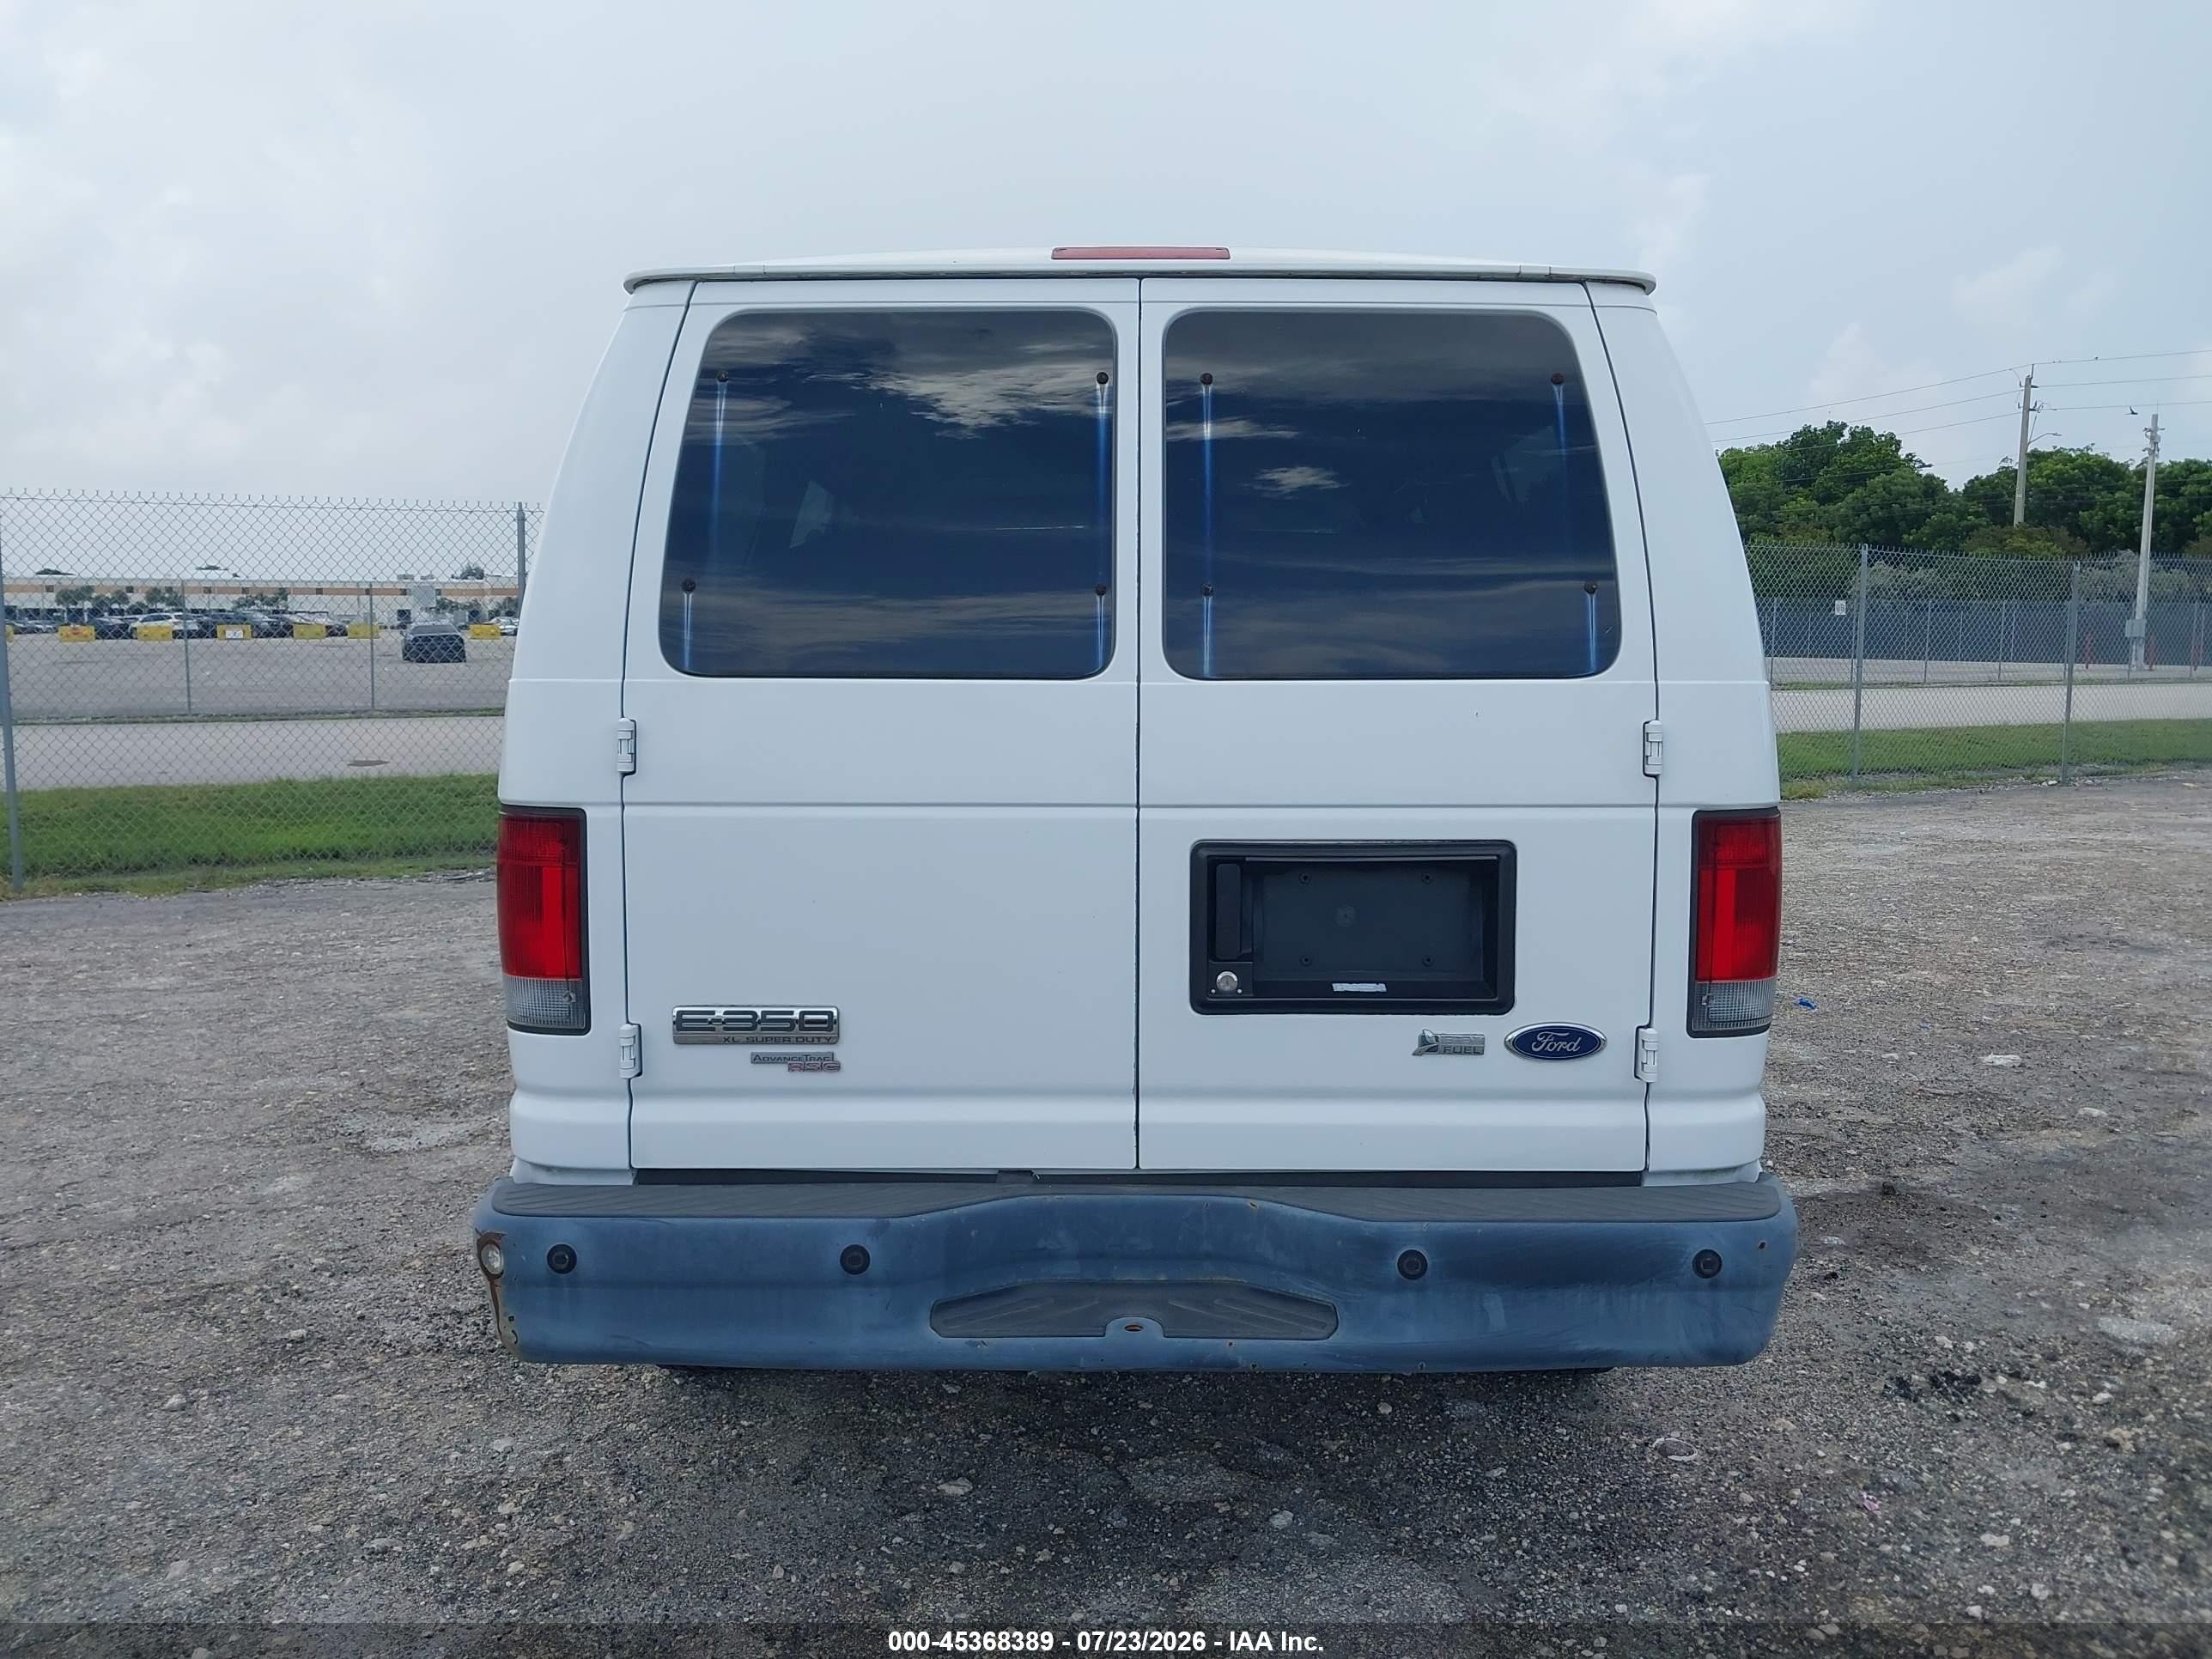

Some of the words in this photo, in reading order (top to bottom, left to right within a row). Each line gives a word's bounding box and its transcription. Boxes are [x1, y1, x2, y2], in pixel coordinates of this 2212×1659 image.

[675, 1009, 835, 1031] E-350
[1443, 1045, 1482, 1054] FUEL
[1531, 1031, 1581, 1052] Ford
